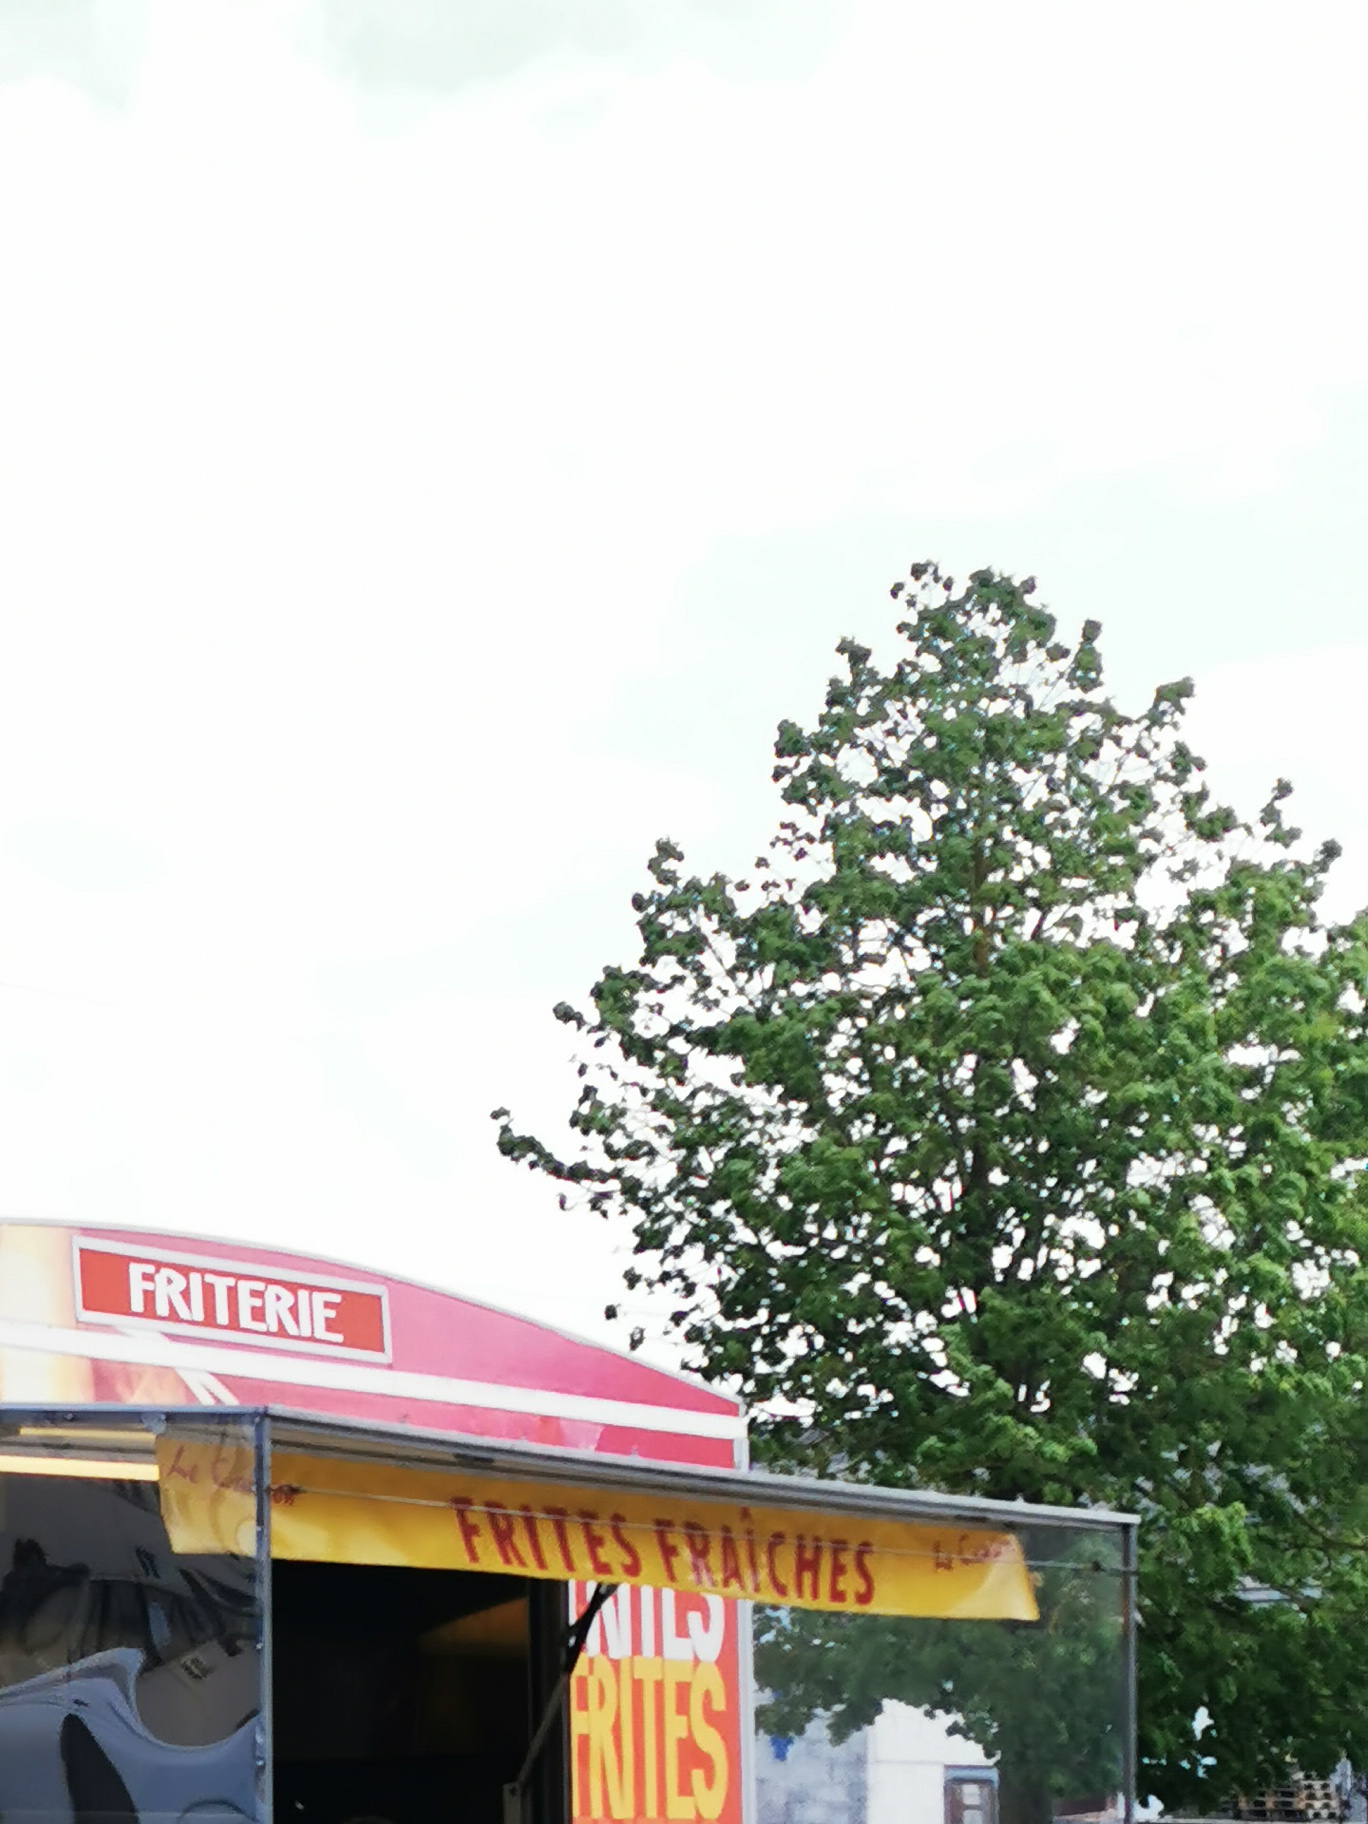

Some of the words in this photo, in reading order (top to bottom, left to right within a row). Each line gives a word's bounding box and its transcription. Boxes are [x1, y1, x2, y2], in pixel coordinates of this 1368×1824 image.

[128, 1261, 344, 1343] FRITERIE
[450, 1496, 641, 1578] FRITES
[652, 1506, 875, 1606] FRAÎCHES
[570, 1652, 729, 1820] FRITES
